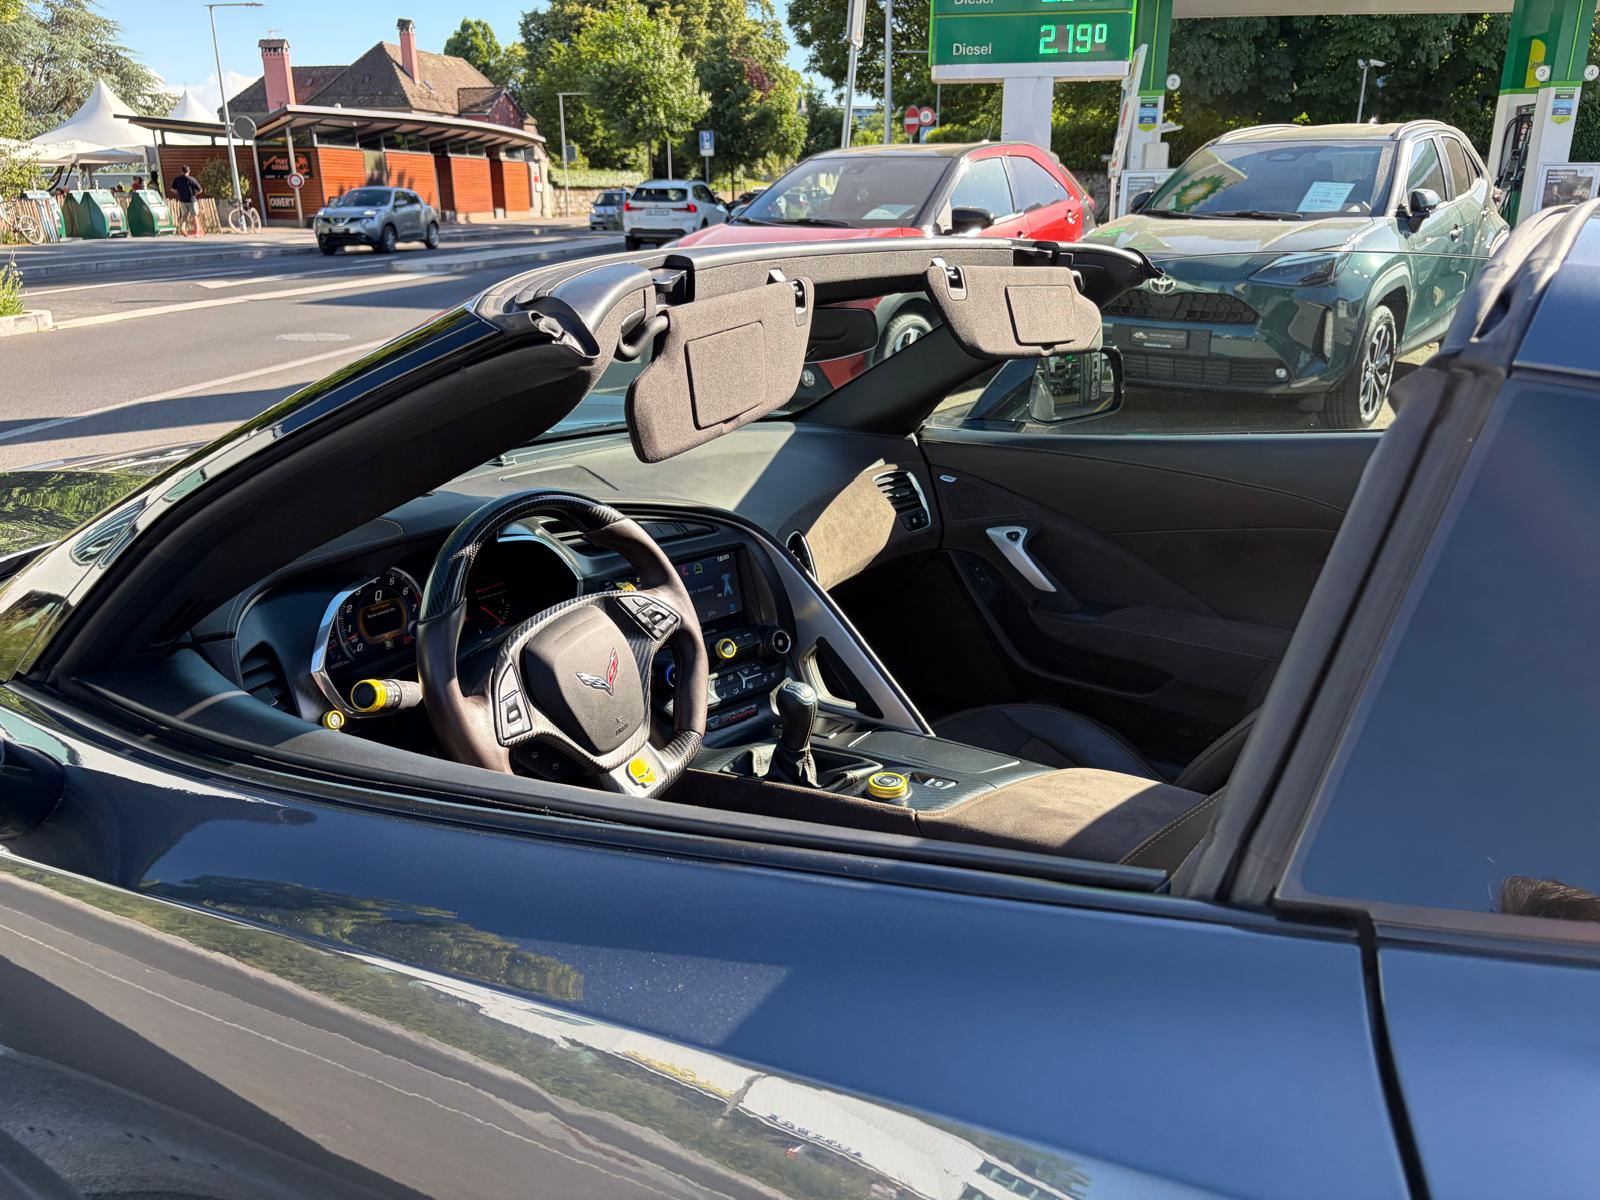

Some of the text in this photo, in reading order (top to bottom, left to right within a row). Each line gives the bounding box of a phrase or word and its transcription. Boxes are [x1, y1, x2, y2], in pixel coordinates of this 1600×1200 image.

[952, 42, 992, 56] Diesel
[389, 577, 395, 585] 5
[374, 589, 382, 601] 0
[346, 604, 353, 613] 2
